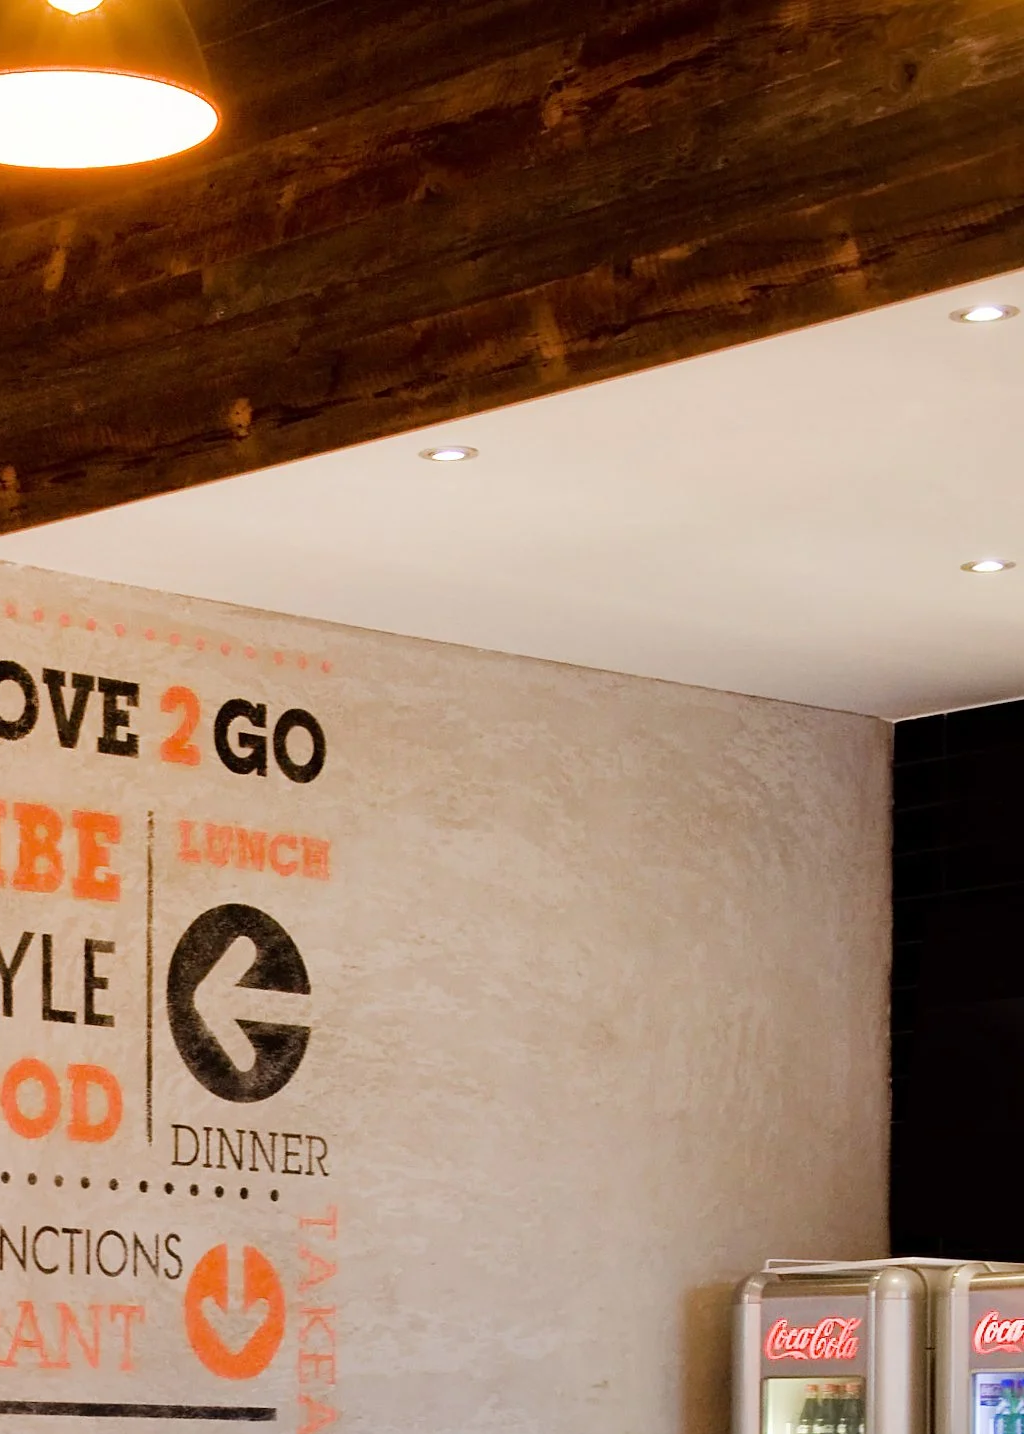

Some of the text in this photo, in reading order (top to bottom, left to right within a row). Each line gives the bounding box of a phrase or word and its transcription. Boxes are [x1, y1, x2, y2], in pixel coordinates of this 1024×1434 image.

[160, 686, 200, 766] 2
[214, 698, 326, 783] GO
[179, 820, 329, 878] LUNCH
[171, 1124, 329, 1176] DINNER
[765, 1316, 861, 1360] Coca-Cola
